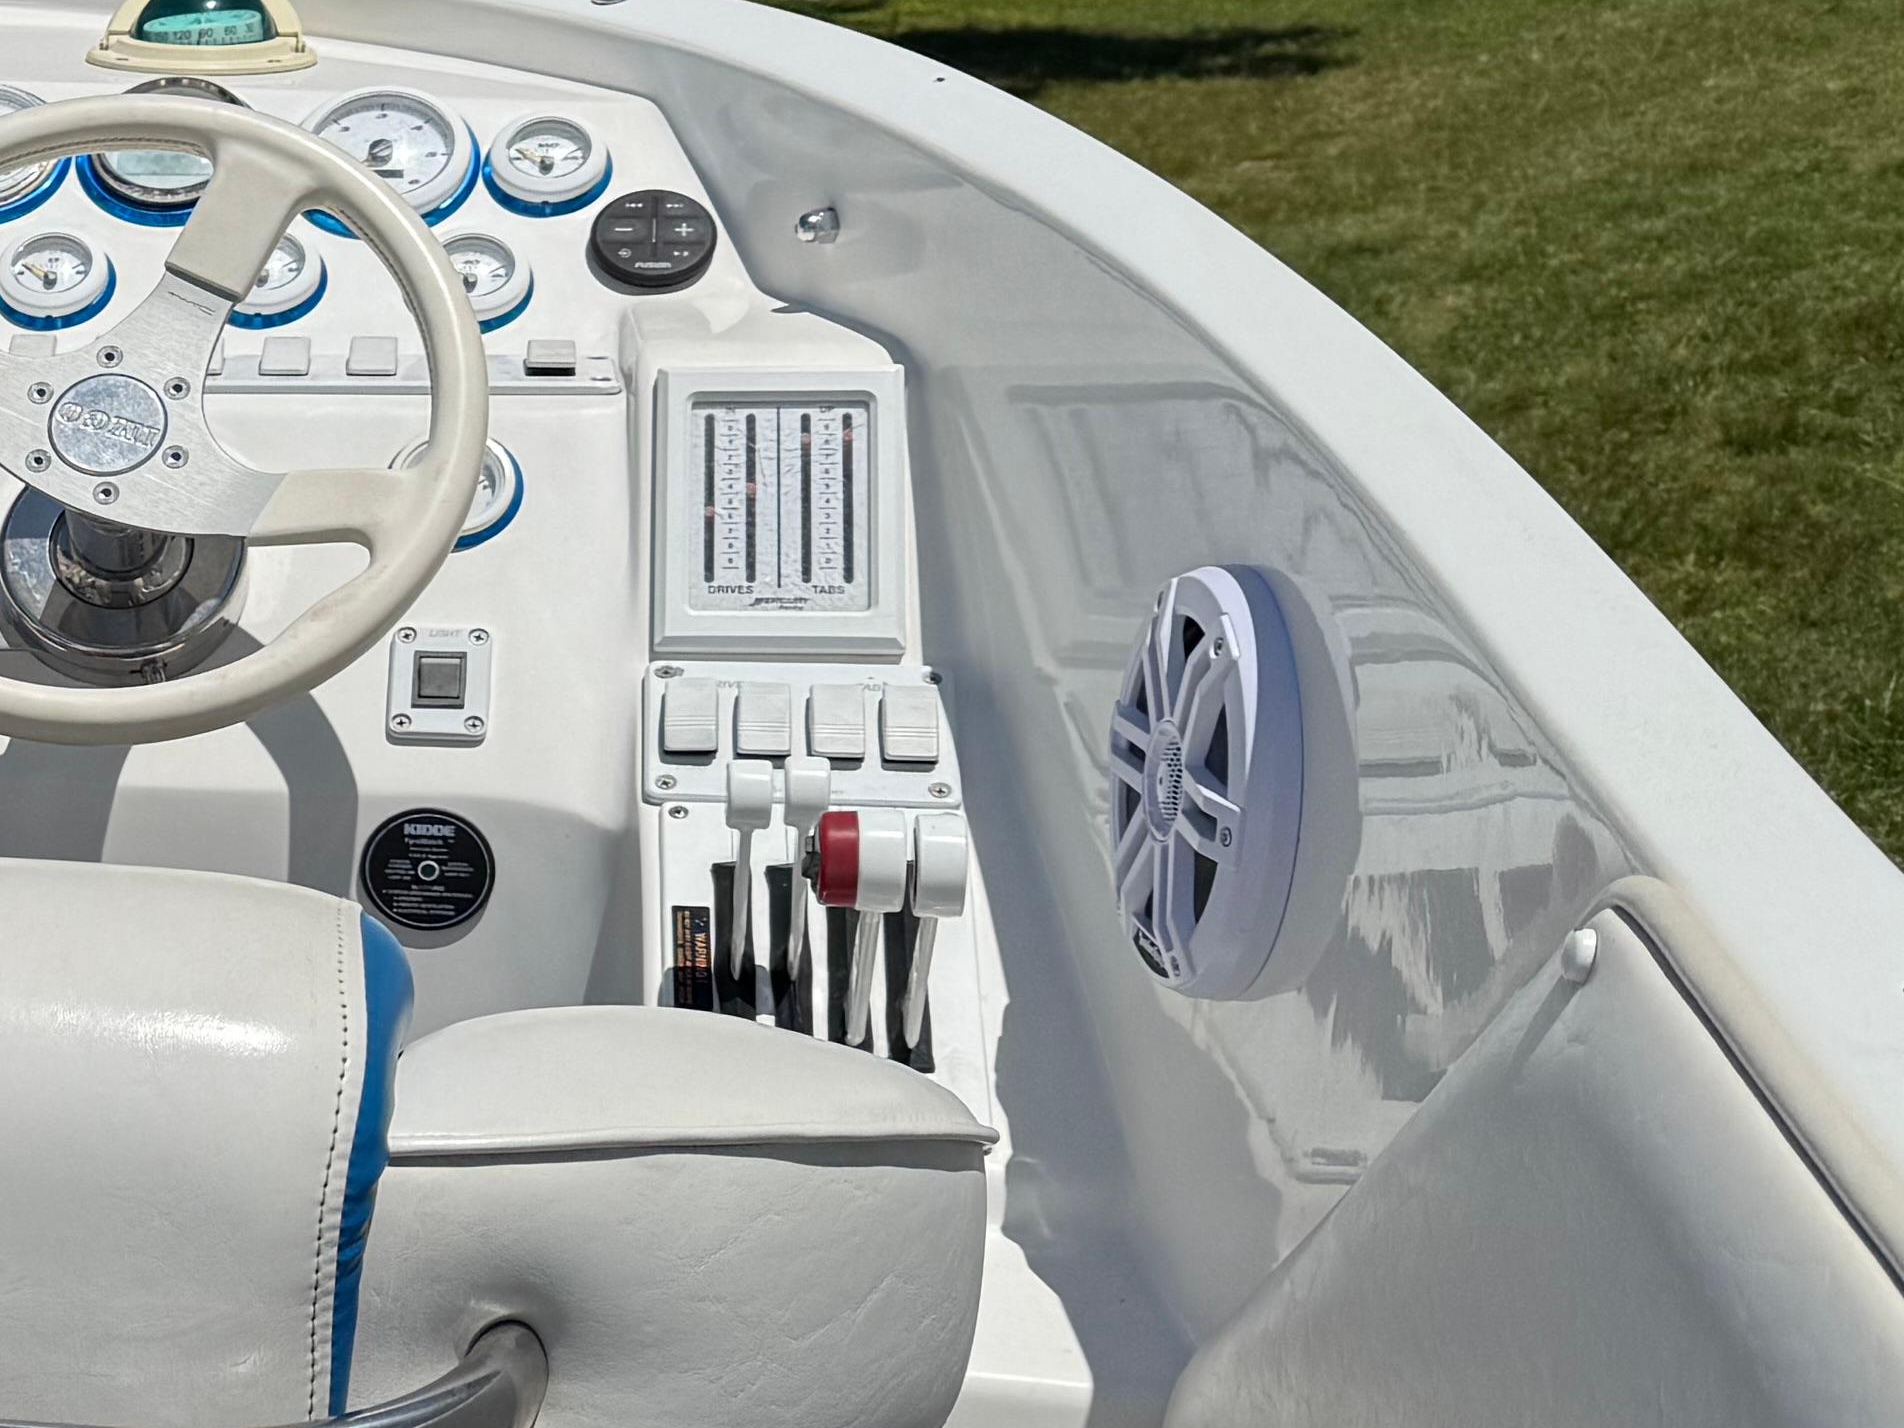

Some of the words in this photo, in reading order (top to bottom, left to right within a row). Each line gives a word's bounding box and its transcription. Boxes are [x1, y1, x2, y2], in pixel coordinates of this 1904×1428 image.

[174, 29, 192, 40] 120
[708, 585, 755, 594] DRIVES
[812, 585, 845, 594] TABS
[404, 823, 456, 837] KIDDE
